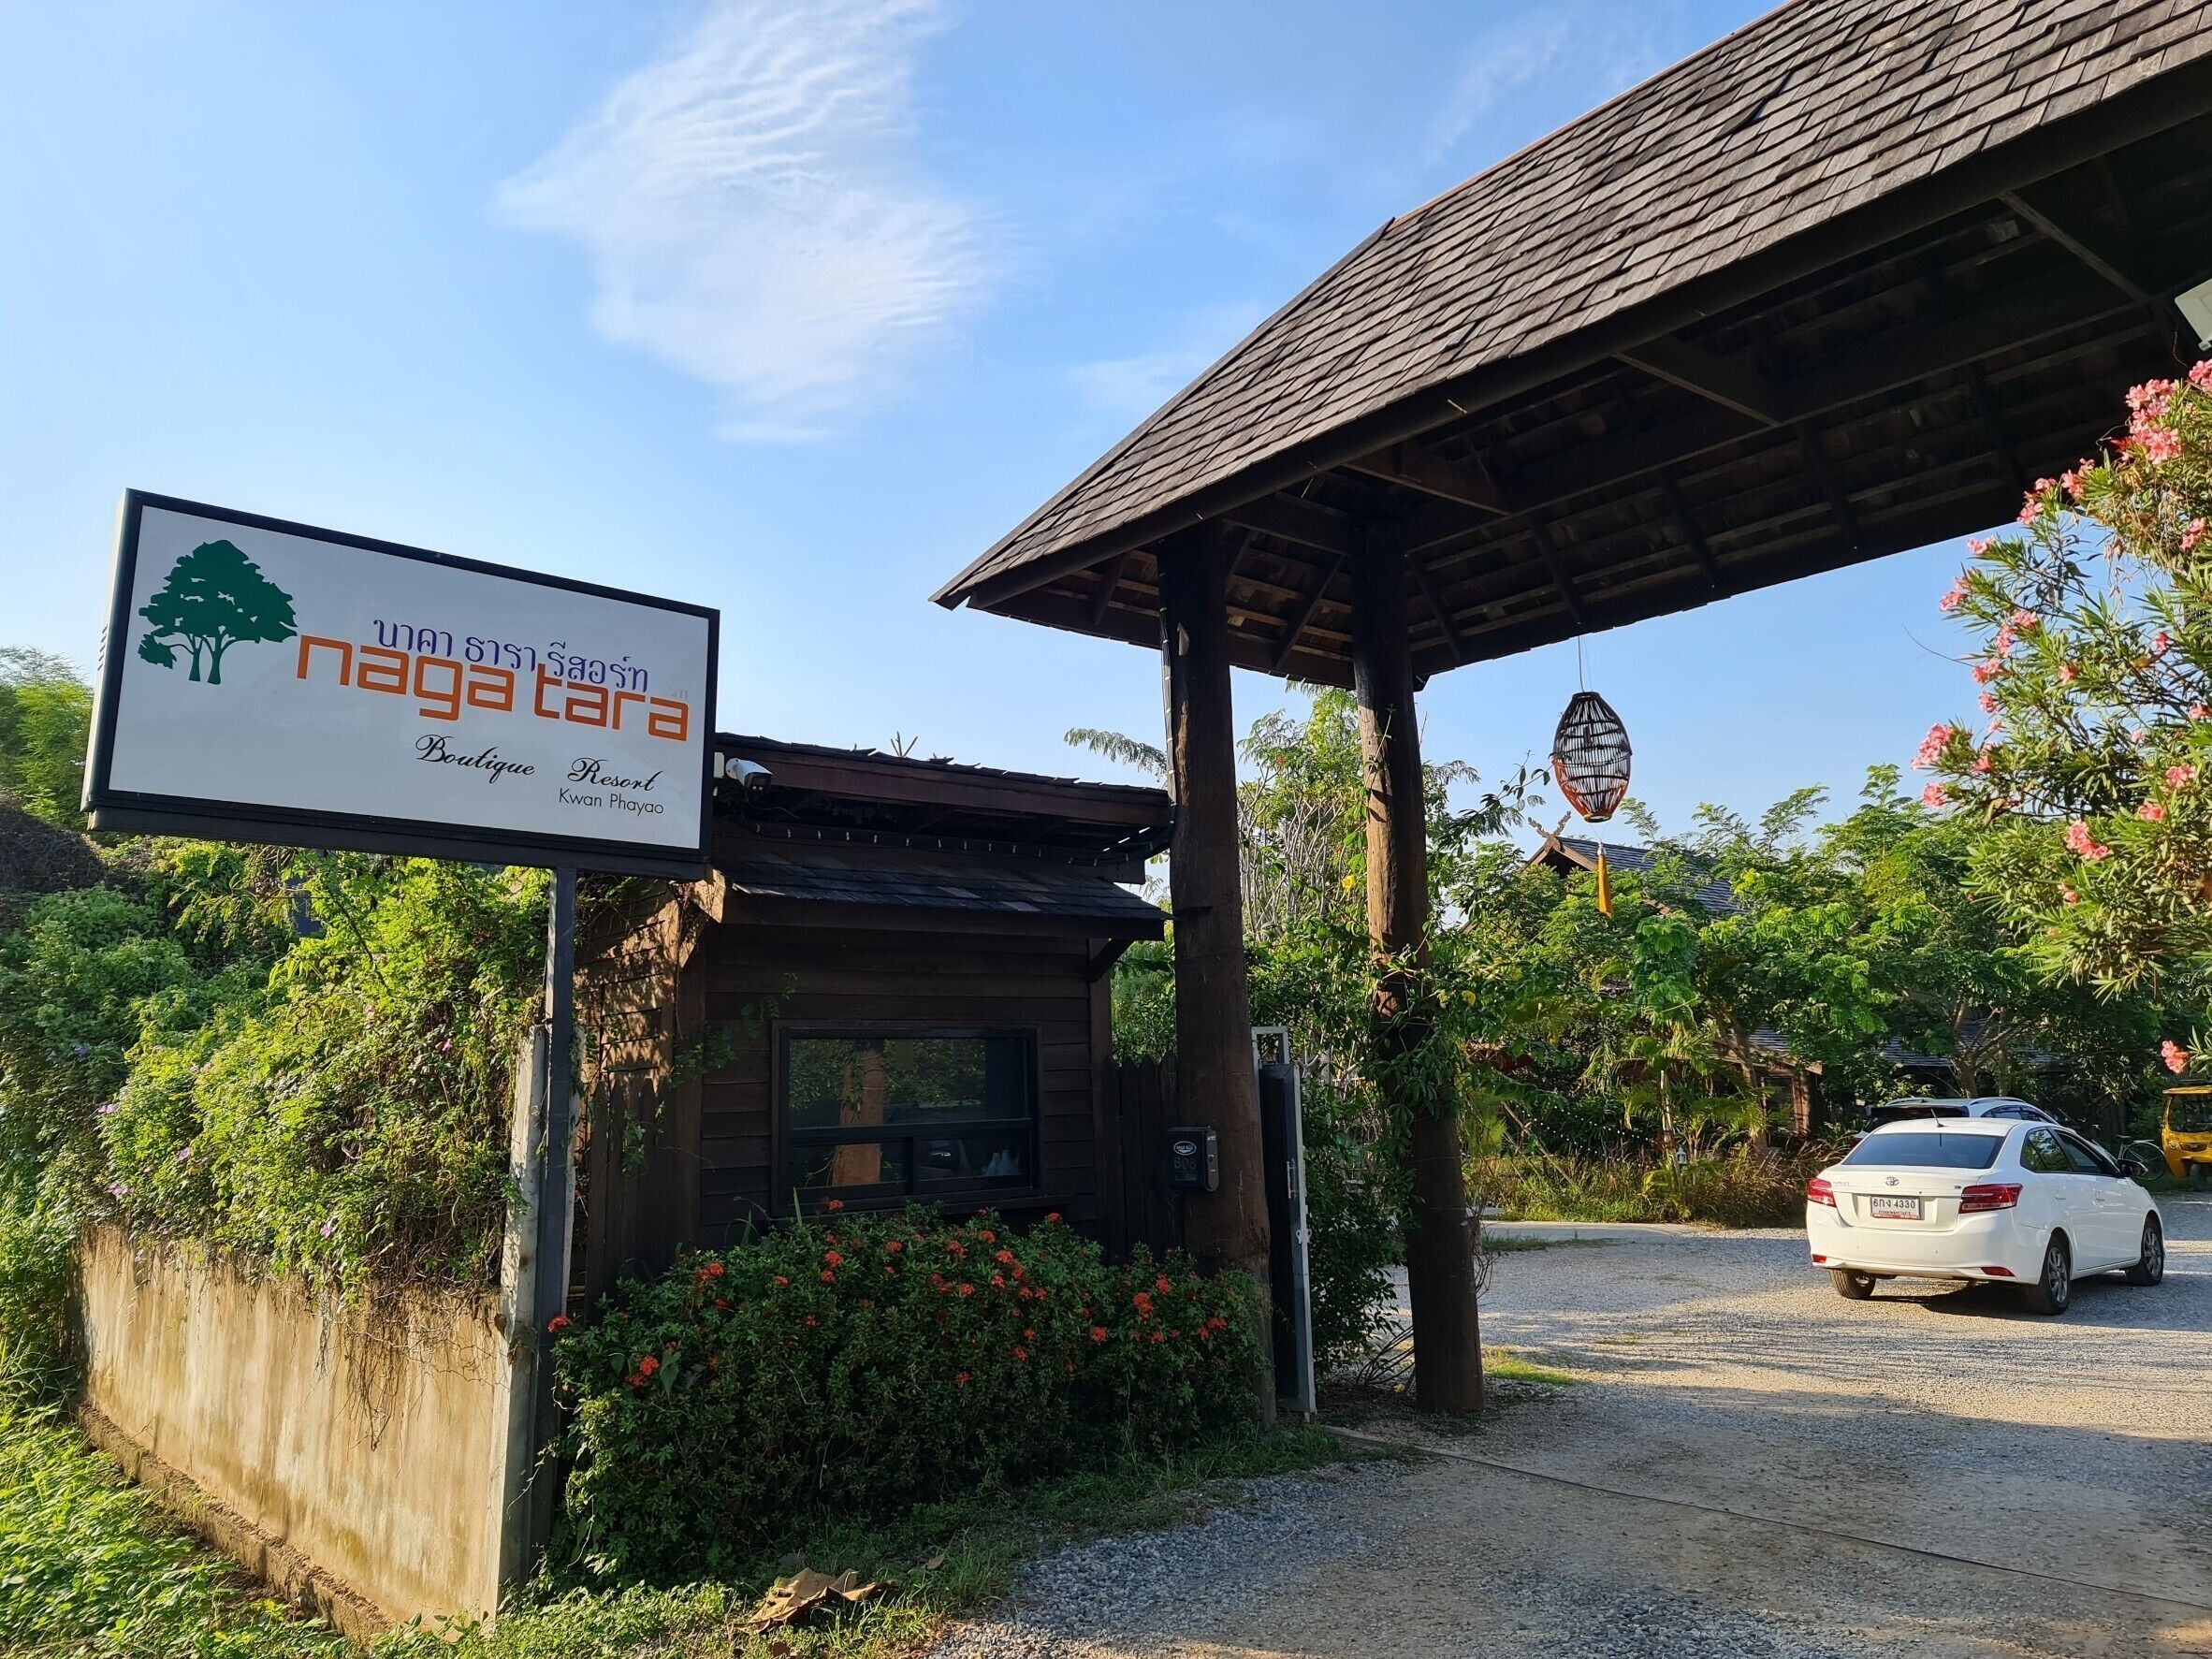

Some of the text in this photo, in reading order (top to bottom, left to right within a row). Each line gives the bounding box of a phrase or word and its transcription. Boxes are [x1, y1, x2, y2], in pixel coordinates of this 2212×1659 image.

[372, 618, 649, 692] นาคา ธารา รีสอร์ท
[297, 634, 690, 742] naga tara
[415, 734, 663, 792] Boutique Resort
[559, 787, 664, 816] Kwan Phayao
[1894, 1200, 1915, 1209] 4330
